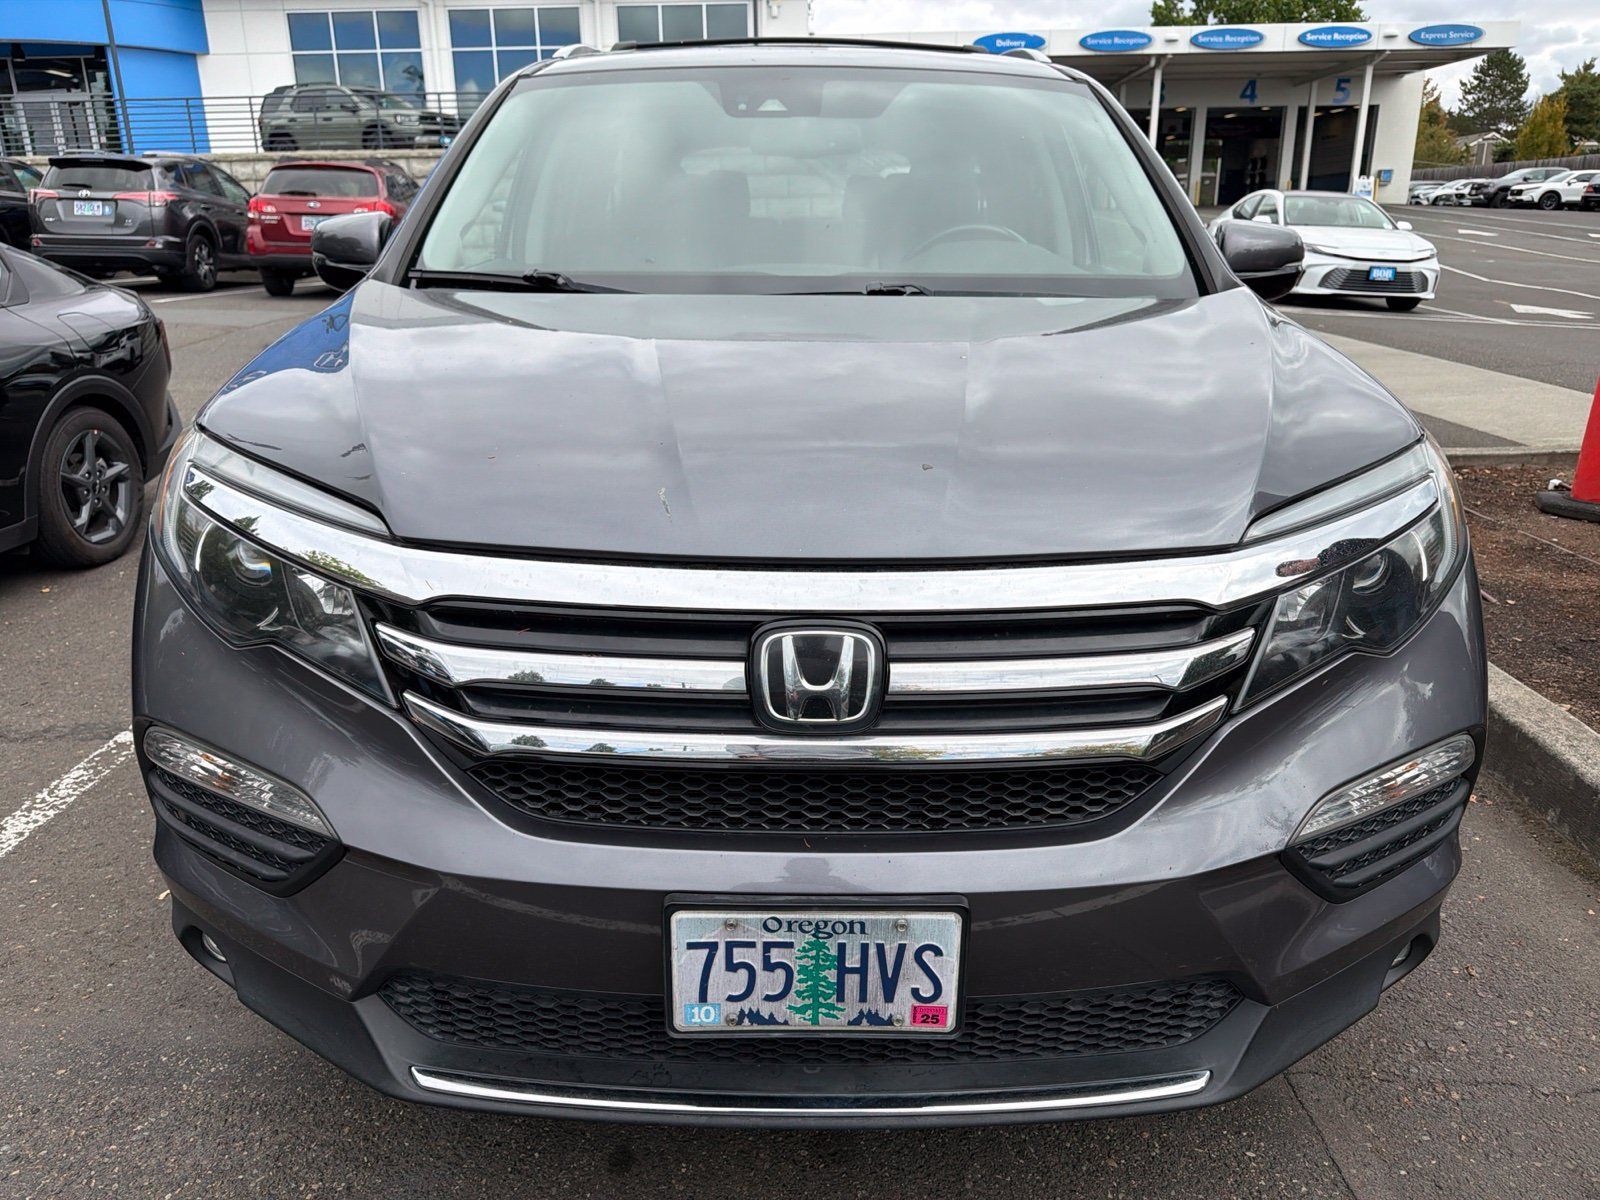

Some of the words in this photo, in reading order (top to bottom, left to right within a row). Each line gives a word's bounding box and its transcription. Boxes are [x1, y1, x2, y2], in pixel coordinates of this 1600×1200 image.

[1086, 36, 1112, 45] Service
[1113, 36, 1149, 45] Reception
[1198, 34, 1223, 43] Service
[1224, 34, 1260, 44] Reception
[1305, 32, 1331, 41] Service
[1333, 32, 1368, 42] Reception
[1421, 31, 1447, 40] Express
[1449, 30, 1476, 39] Service
[995, 38, 1026, 48] Delivery
[1239, 79, 1258, 104] 4
[1332, 78, 1351, 104] 5
[762, 916, 869, 940] Oregon
[686, 941, 795, 1004] 755
[836, 942, 944, 1005] HVS
[691, 1006, 715, 1023] 10
[920, 1013, 940, 1025] 25
